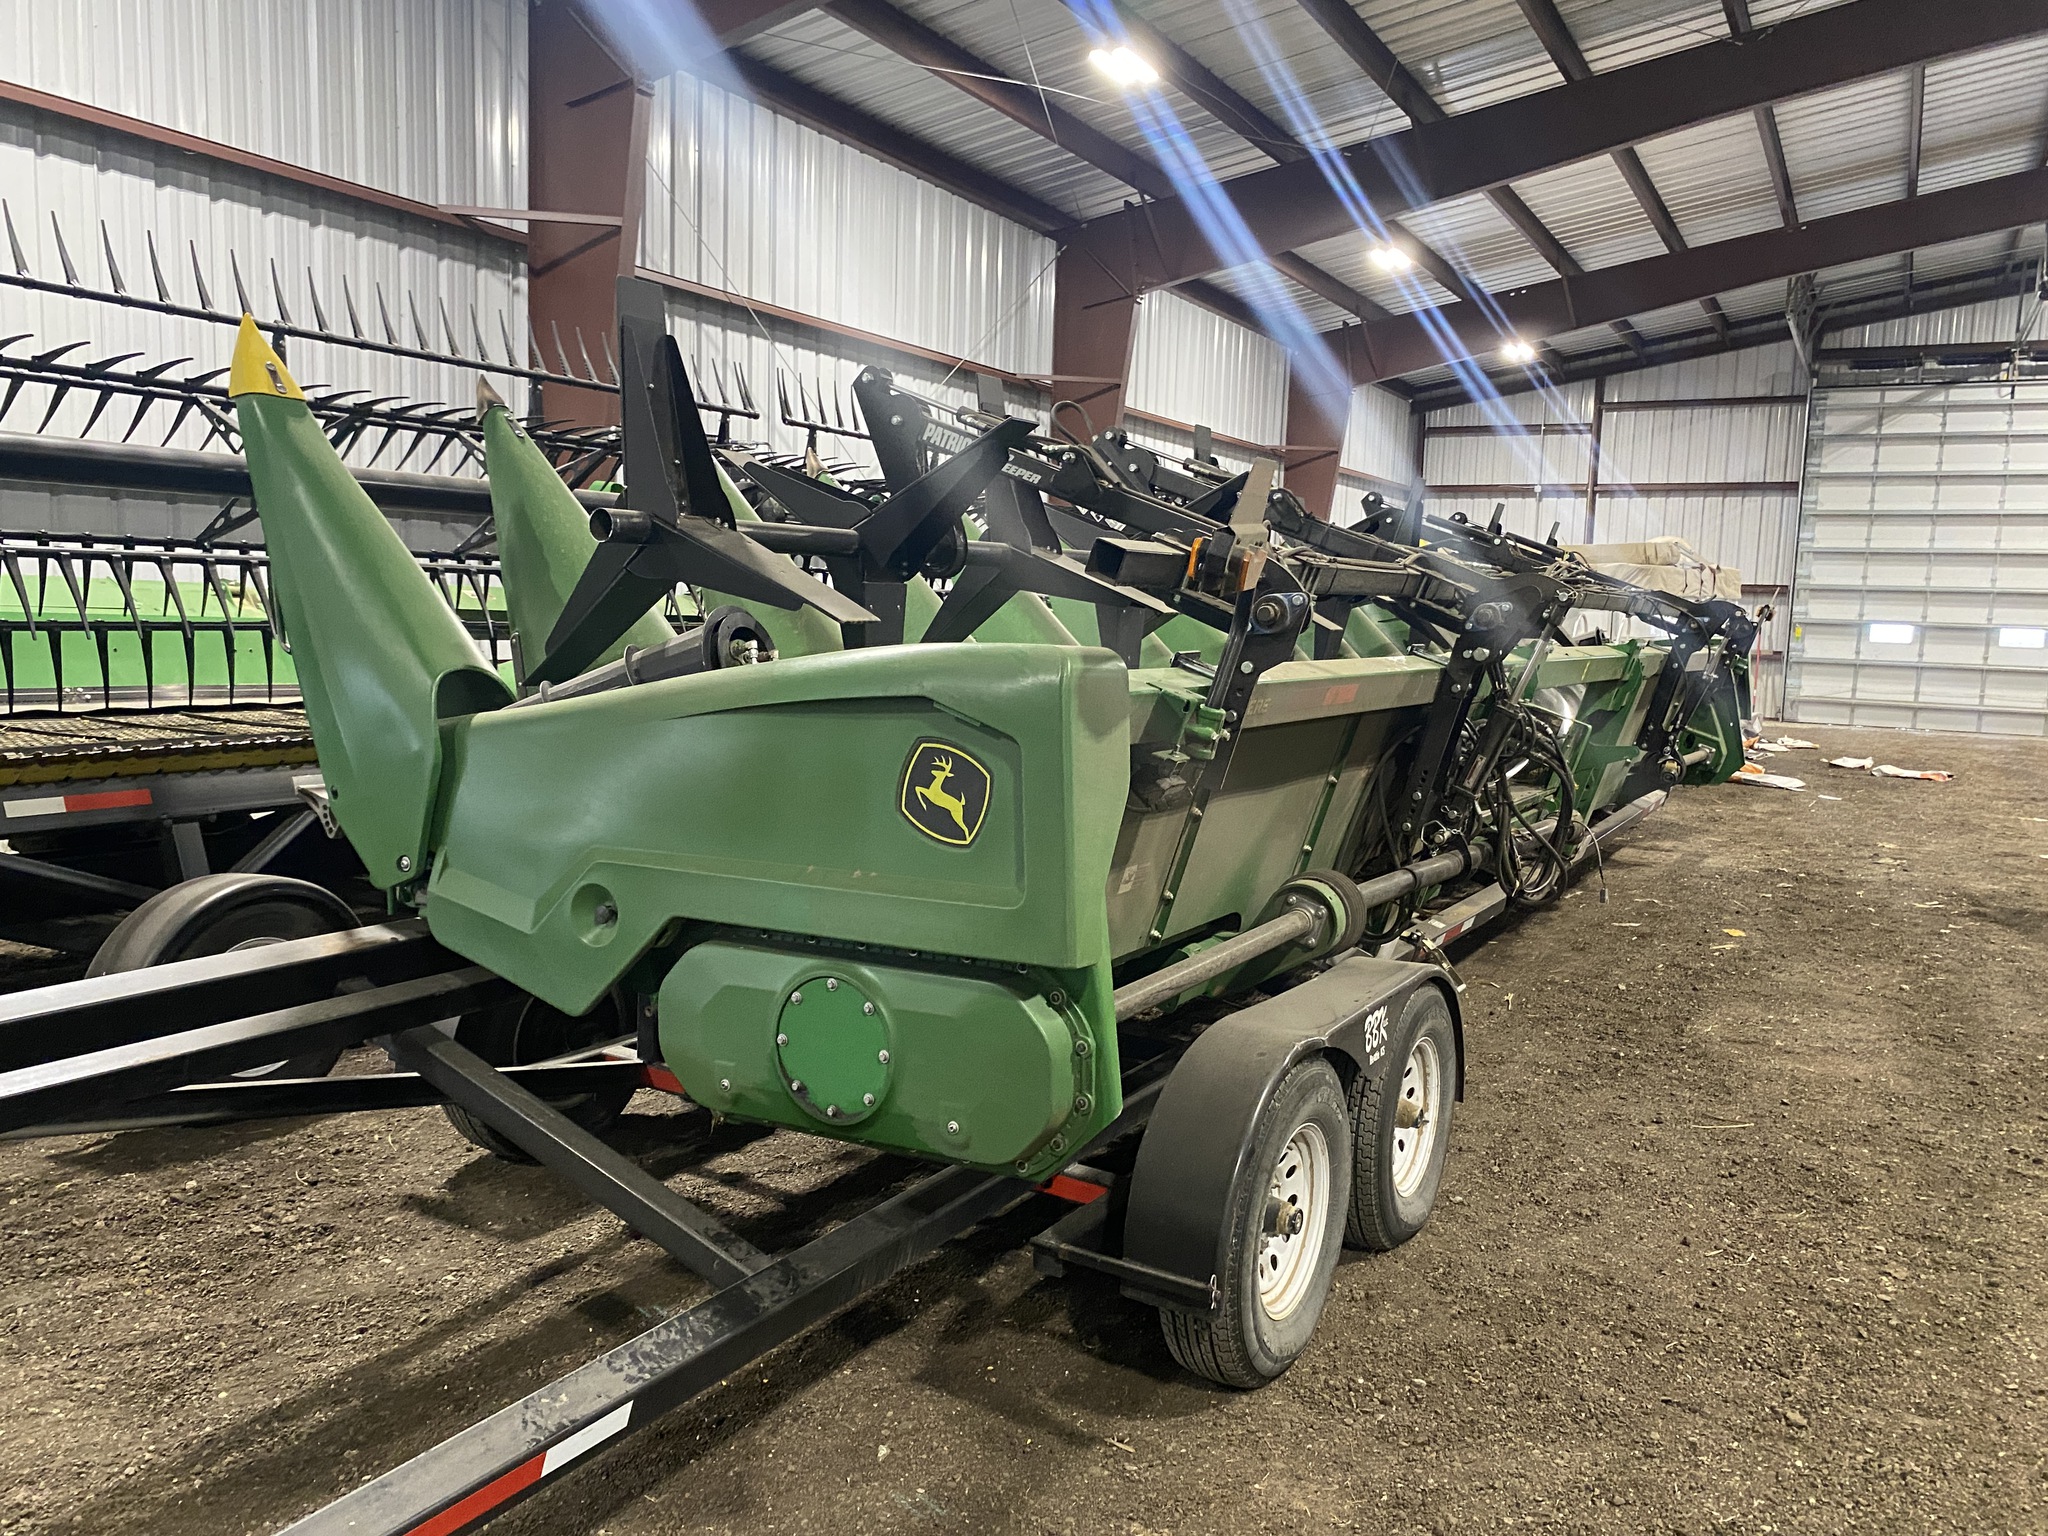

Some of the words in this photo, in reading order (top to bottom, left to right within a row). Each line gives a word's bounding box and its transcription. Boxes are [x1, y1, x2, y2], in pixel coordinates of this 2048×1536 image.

[922, 422, 973, 454] PATRIO
[1001, 462, 1042, 484] EEPER
[1247, 697, 1272, 716] ERE
[1364, 1005, 1388, 1053] BBK
